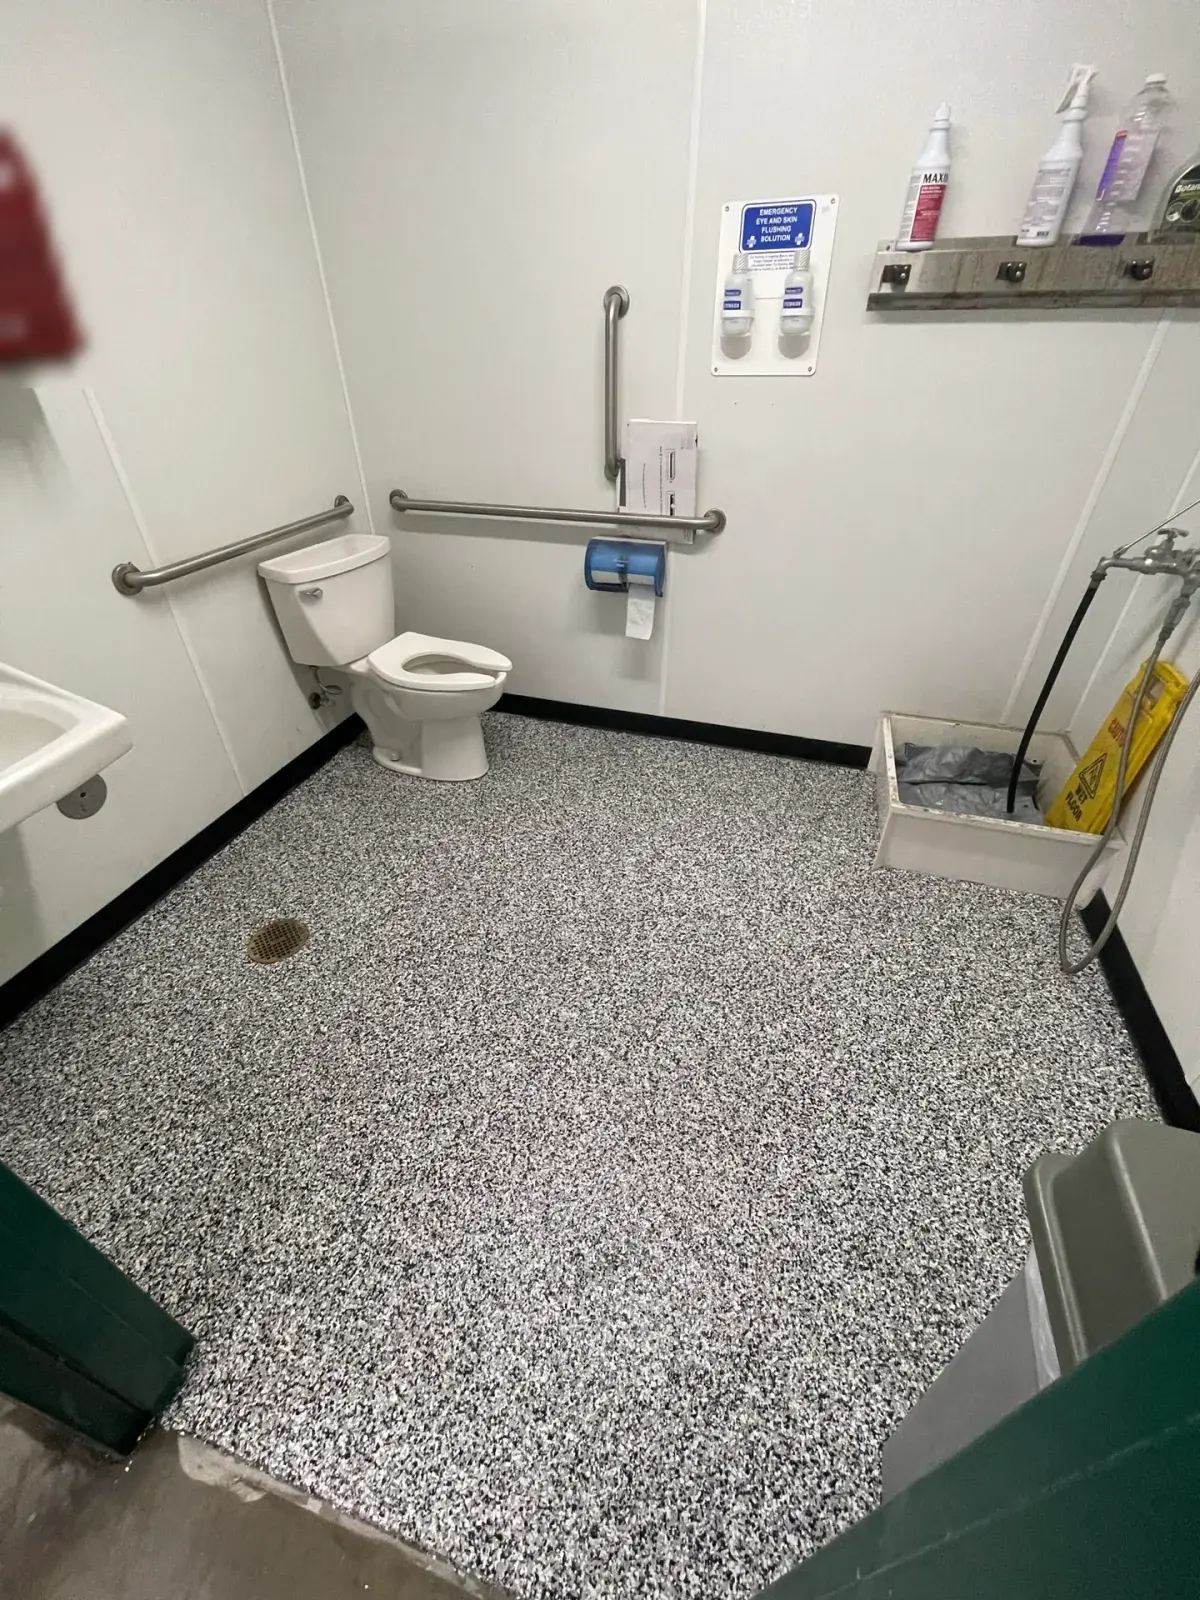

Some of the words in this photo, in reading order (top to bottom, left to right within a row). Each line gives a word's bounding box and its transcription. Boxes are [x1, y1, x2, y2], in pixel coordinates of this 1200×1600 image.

[759, 206, 798, 216] EMERGENCY
[755, 217, 769, 225] EYE
[768, 217, 782, 225] AND
[782, 215, 798, 224] SKIN
[761, 225, 792, 234] FLUSHING
[760, 234, 791, 243] SOLUTION
[1075, 783, 1088, 805] WET
[1065, 790, 1082, 822] FLOOR
